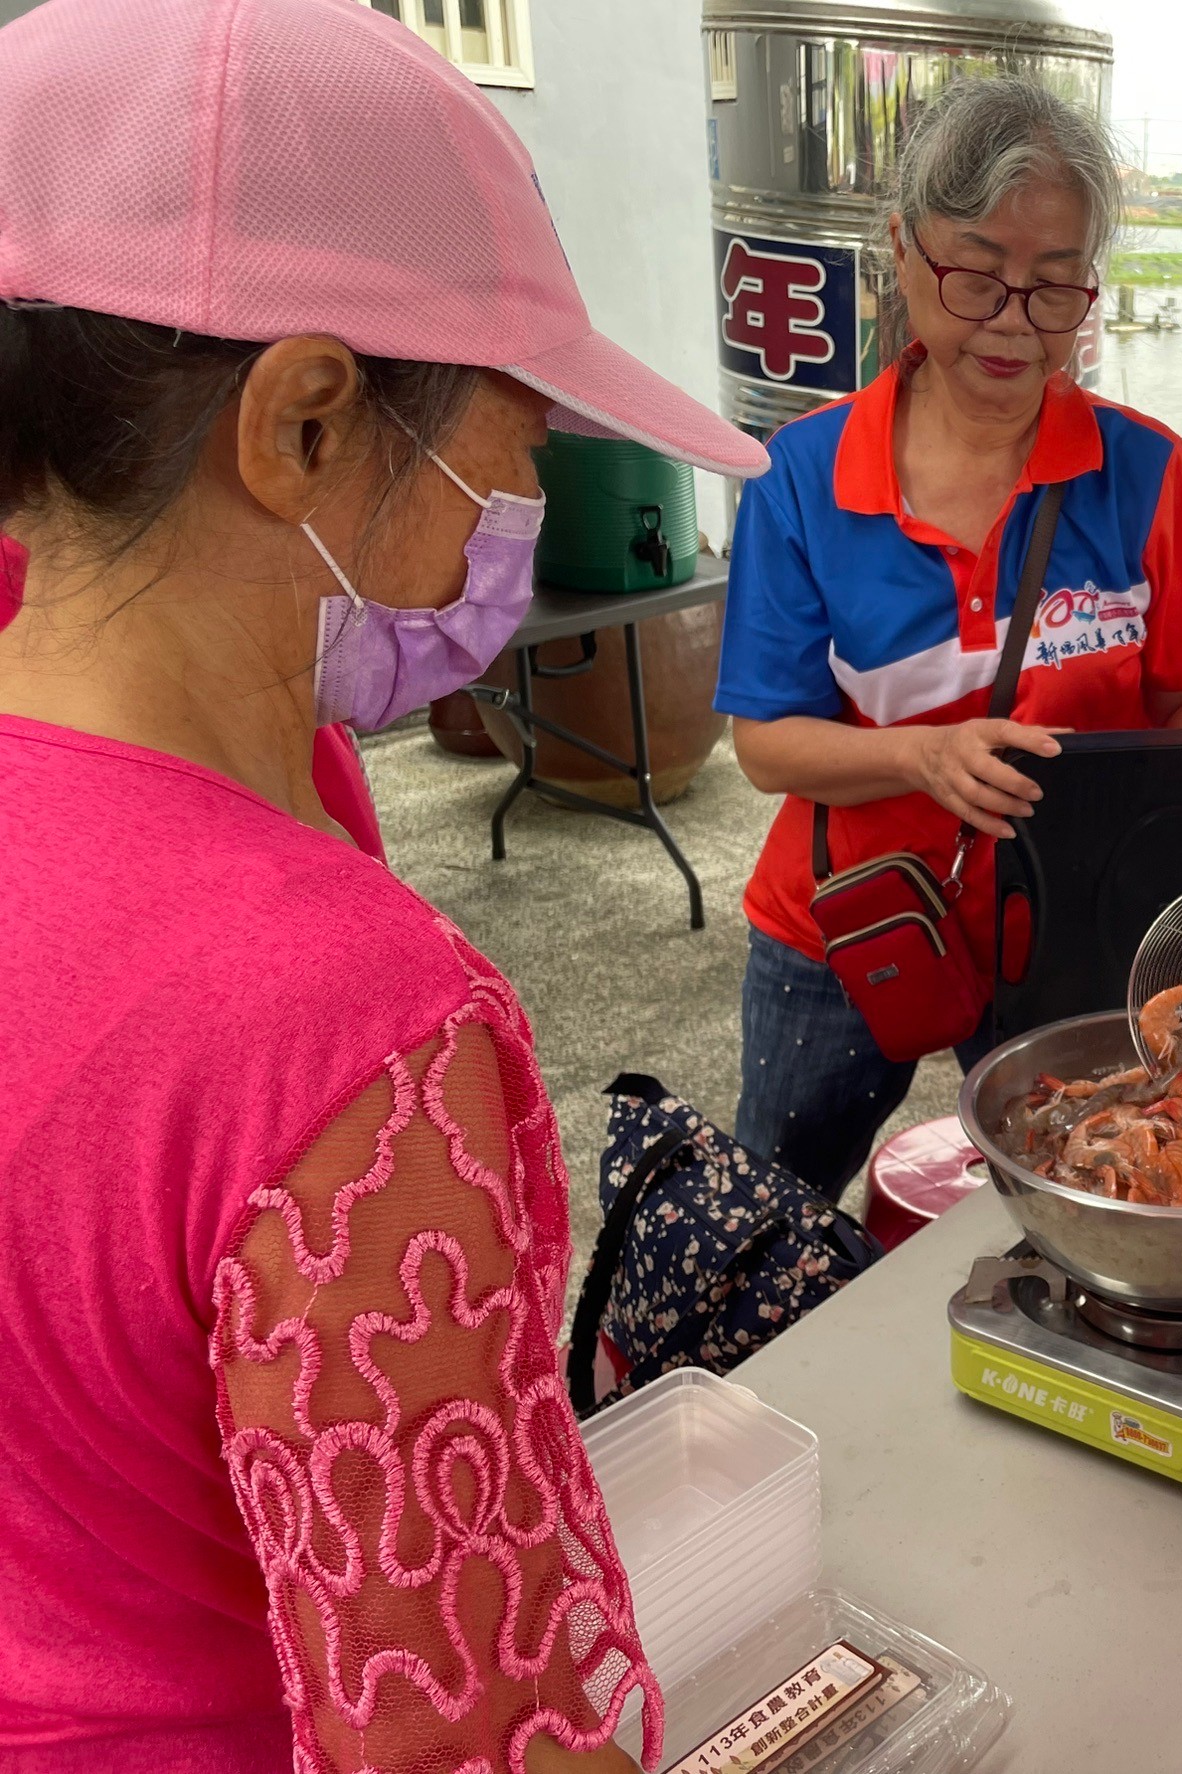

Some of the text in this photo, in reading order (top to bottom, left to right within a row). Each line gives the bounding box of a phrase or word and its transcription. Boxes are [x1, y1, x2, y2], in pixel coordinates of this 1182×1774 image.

[721, 238, 835, 381] 年
[698, 1667, 822, 1767] 113年食農教育
[750, 1683, 839, 1757] 創新整合計畫
